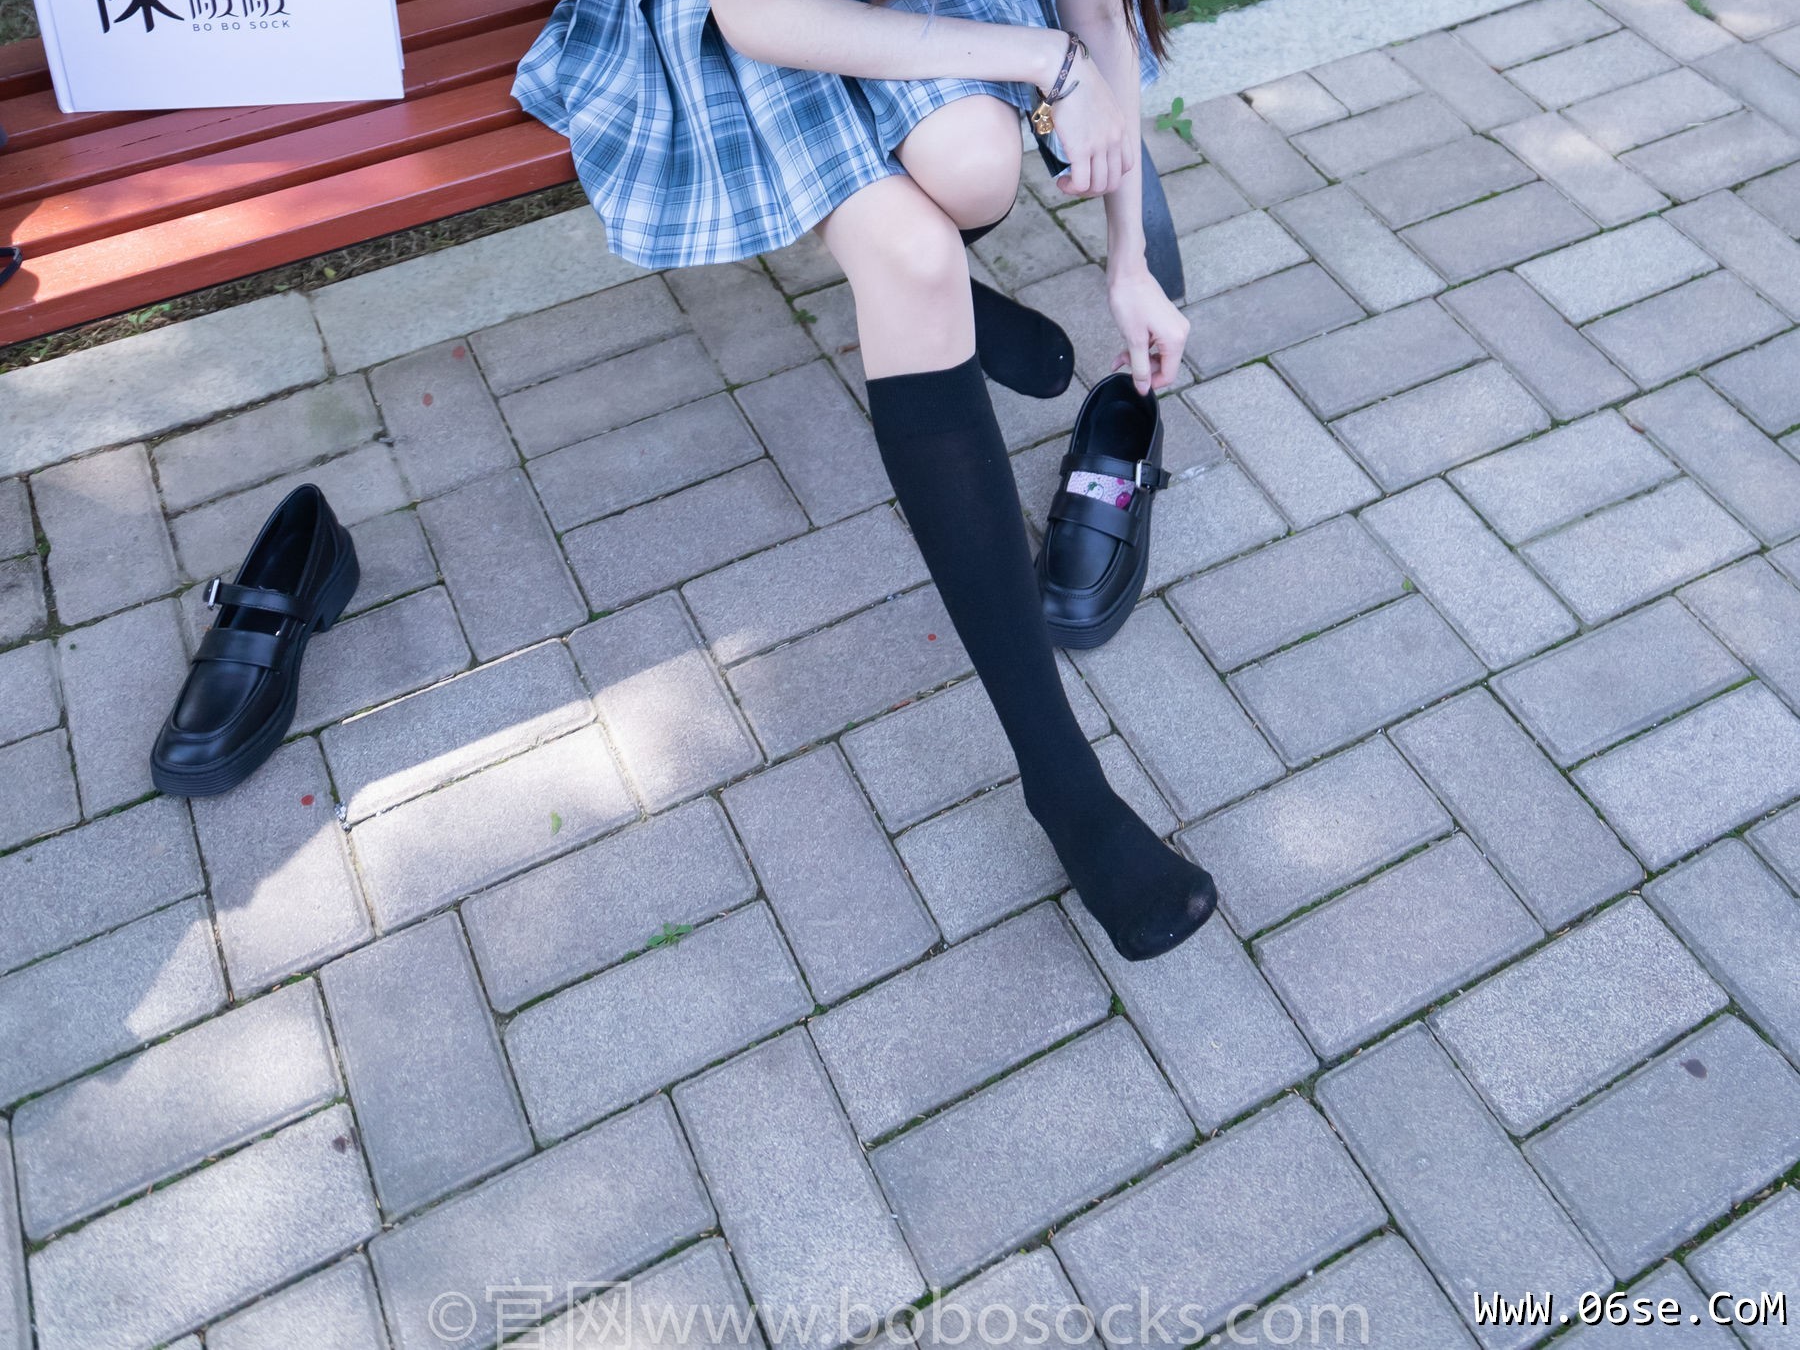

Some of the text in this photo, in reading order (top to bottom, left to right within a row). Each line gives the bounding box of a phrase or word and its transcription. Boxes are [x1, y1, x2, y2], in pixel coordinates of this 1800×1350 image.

[192, 20, 291, 32] BO BO SOCK
